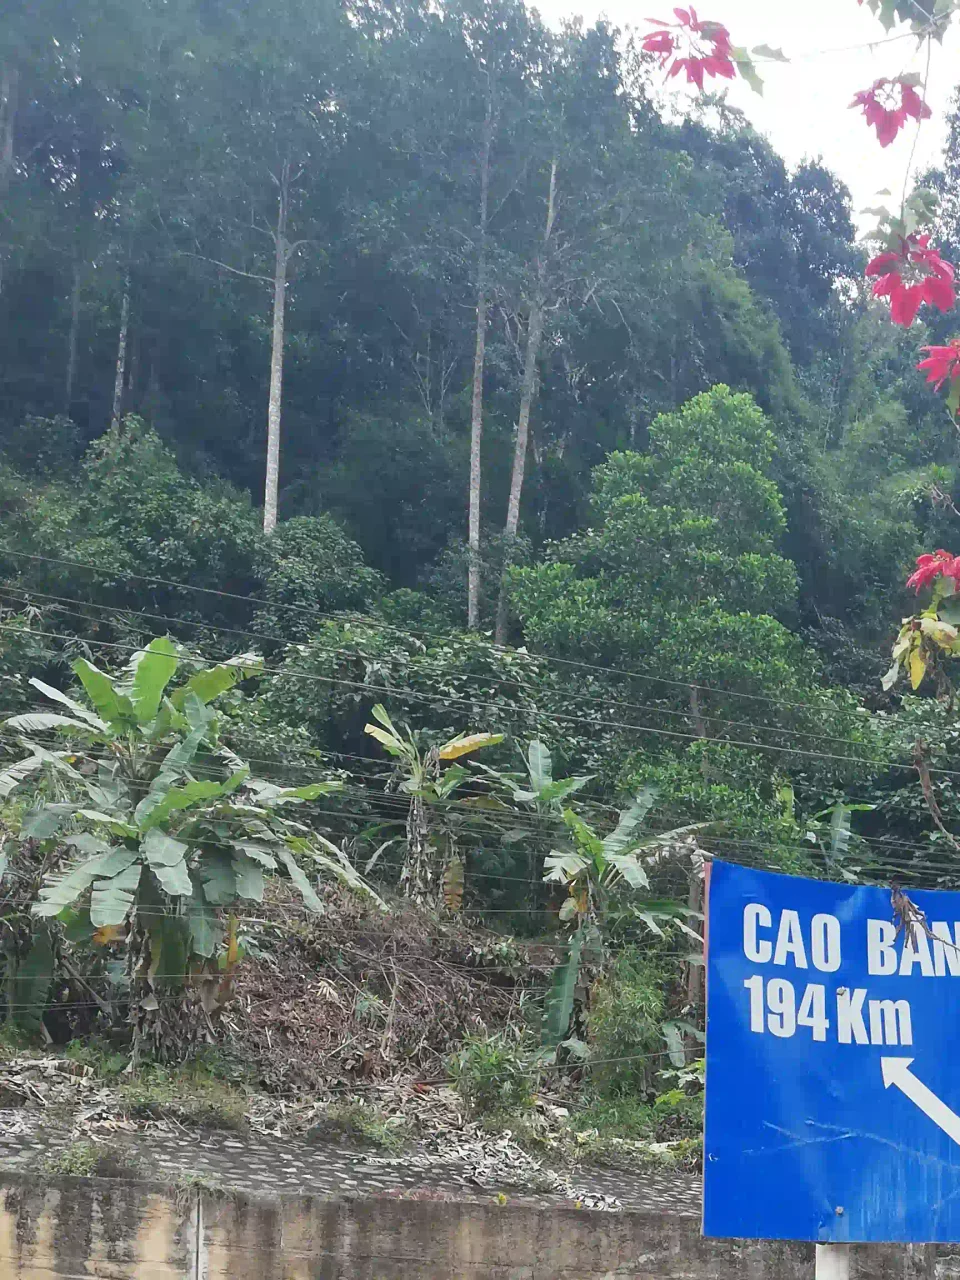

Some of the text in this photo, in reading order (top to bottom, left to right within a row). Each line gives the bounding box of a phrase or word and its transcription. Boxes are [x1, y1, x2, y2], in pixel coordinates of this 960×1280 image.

[743, 902, 842, 973] CAO
[743, 975, 913, 1046] 194 Km
